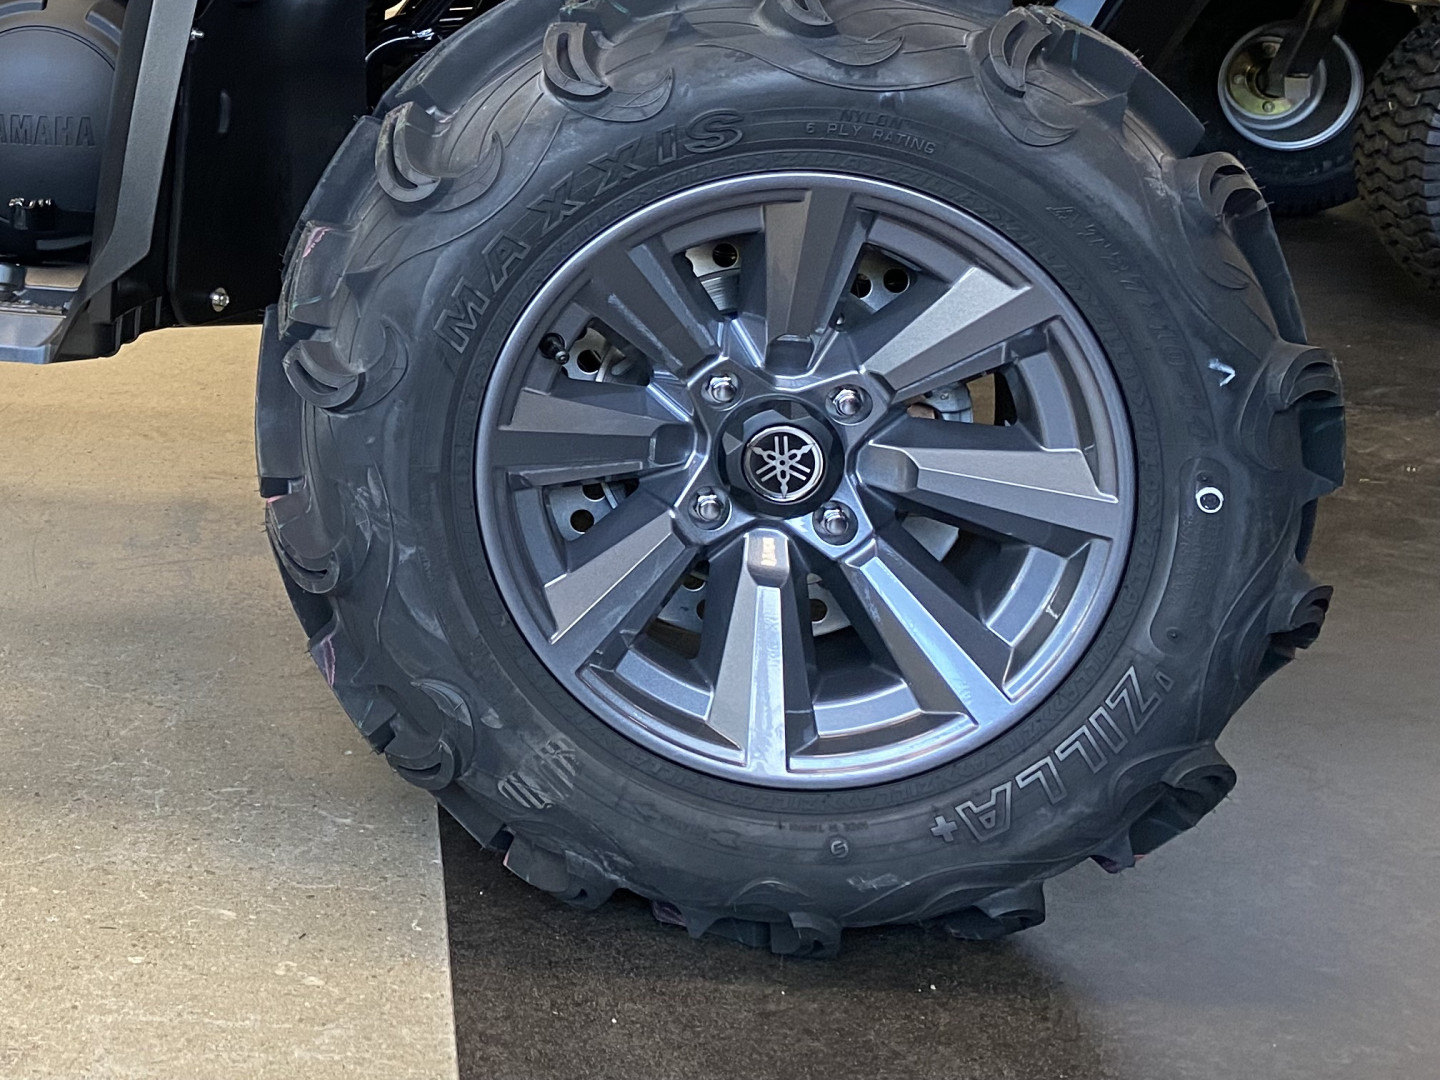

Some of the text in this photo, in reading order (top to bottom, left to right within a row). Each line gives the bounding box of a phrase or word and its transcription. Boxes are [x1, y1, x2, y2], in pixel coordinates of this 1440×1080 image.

[827, 123, 861, 137] PLY
[873, 129, 937, 155] RATING
[433, 108, 744, 354] MAXXIS
